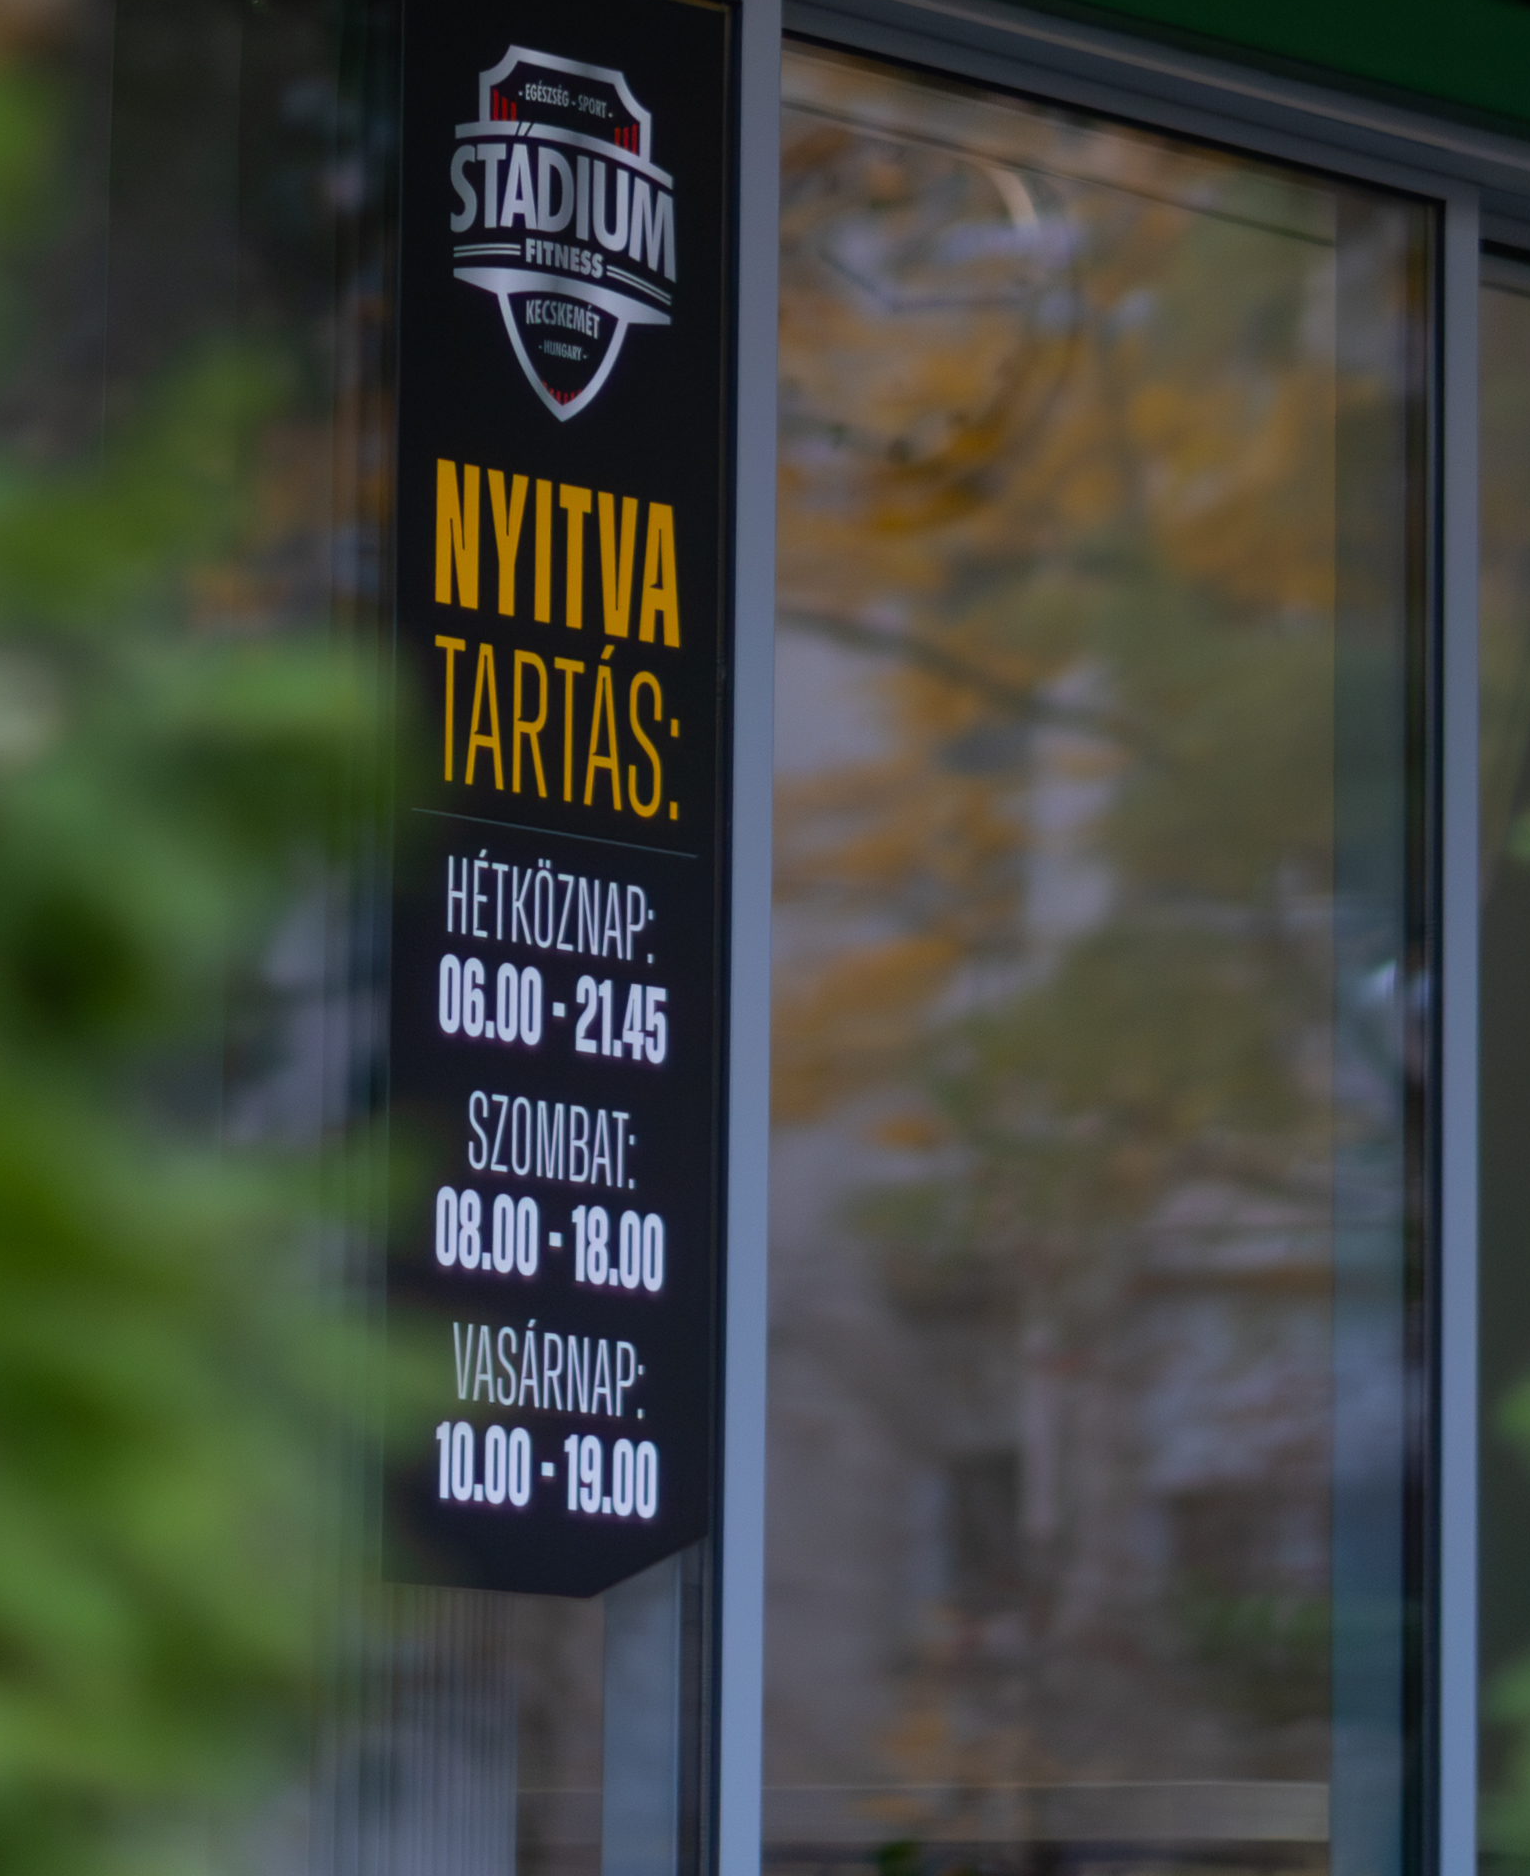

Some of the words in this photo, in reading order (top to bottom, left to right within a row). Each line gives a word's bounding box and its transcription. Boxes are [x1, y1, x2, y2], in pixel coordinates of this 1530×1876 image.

[525, 80, 569, 107] EGÉSZSÉG
[578, 94, 607, 119] SPORT
[525, 237, 604, 279] FITNESS
[526, 299, 601, 340] KECSKEMÉT
[543, 339, 583, 362] HUNGARY
[435, 458, 681, 648] NYITVA
[435, 634, 679, 821] TARTÁS:
[447, 849, 655, 964] HÉTKÖZNAP:
[438, 953, 543, 1046] 06.00
[575, 974, 667, 1065] 21.45
[468, 1090, 636, 1190] SZOMBAT:
[436, 1185, 540, 1277] 08.00
[571, 1205, 666, 1293] 18.00
[453, 1319, 645, 1420] VASÁRNAP:
[436, 1421, 532, 1507] 10.00
[564, 1434, 658, 1519] 19.00
